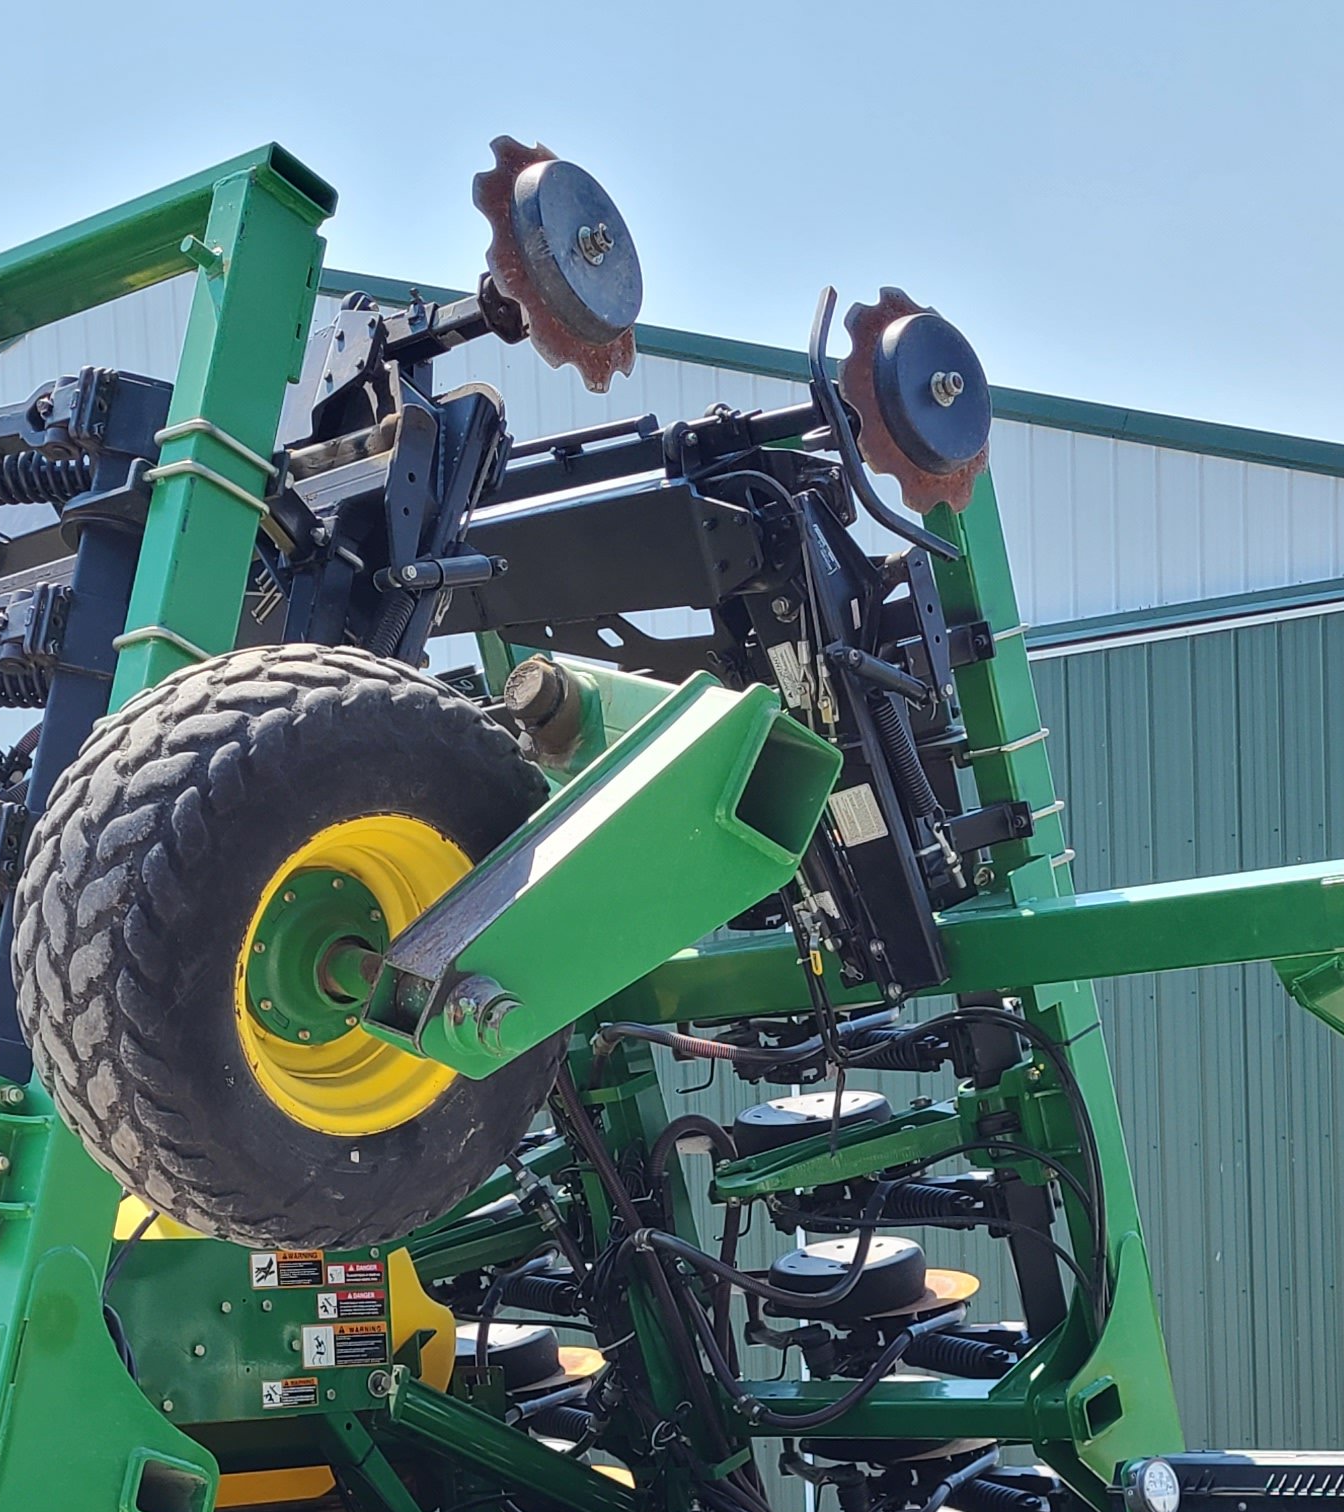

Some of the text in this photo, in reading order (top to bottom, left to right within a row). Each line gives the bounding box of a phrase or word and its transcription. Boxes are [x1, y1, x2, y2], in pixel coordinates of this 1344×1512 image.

[288, 1251, 318, 1259] WARNING
[353, 1291, 375, 1299] DANGER
[348, 1325, 382, 1333] WARNING
